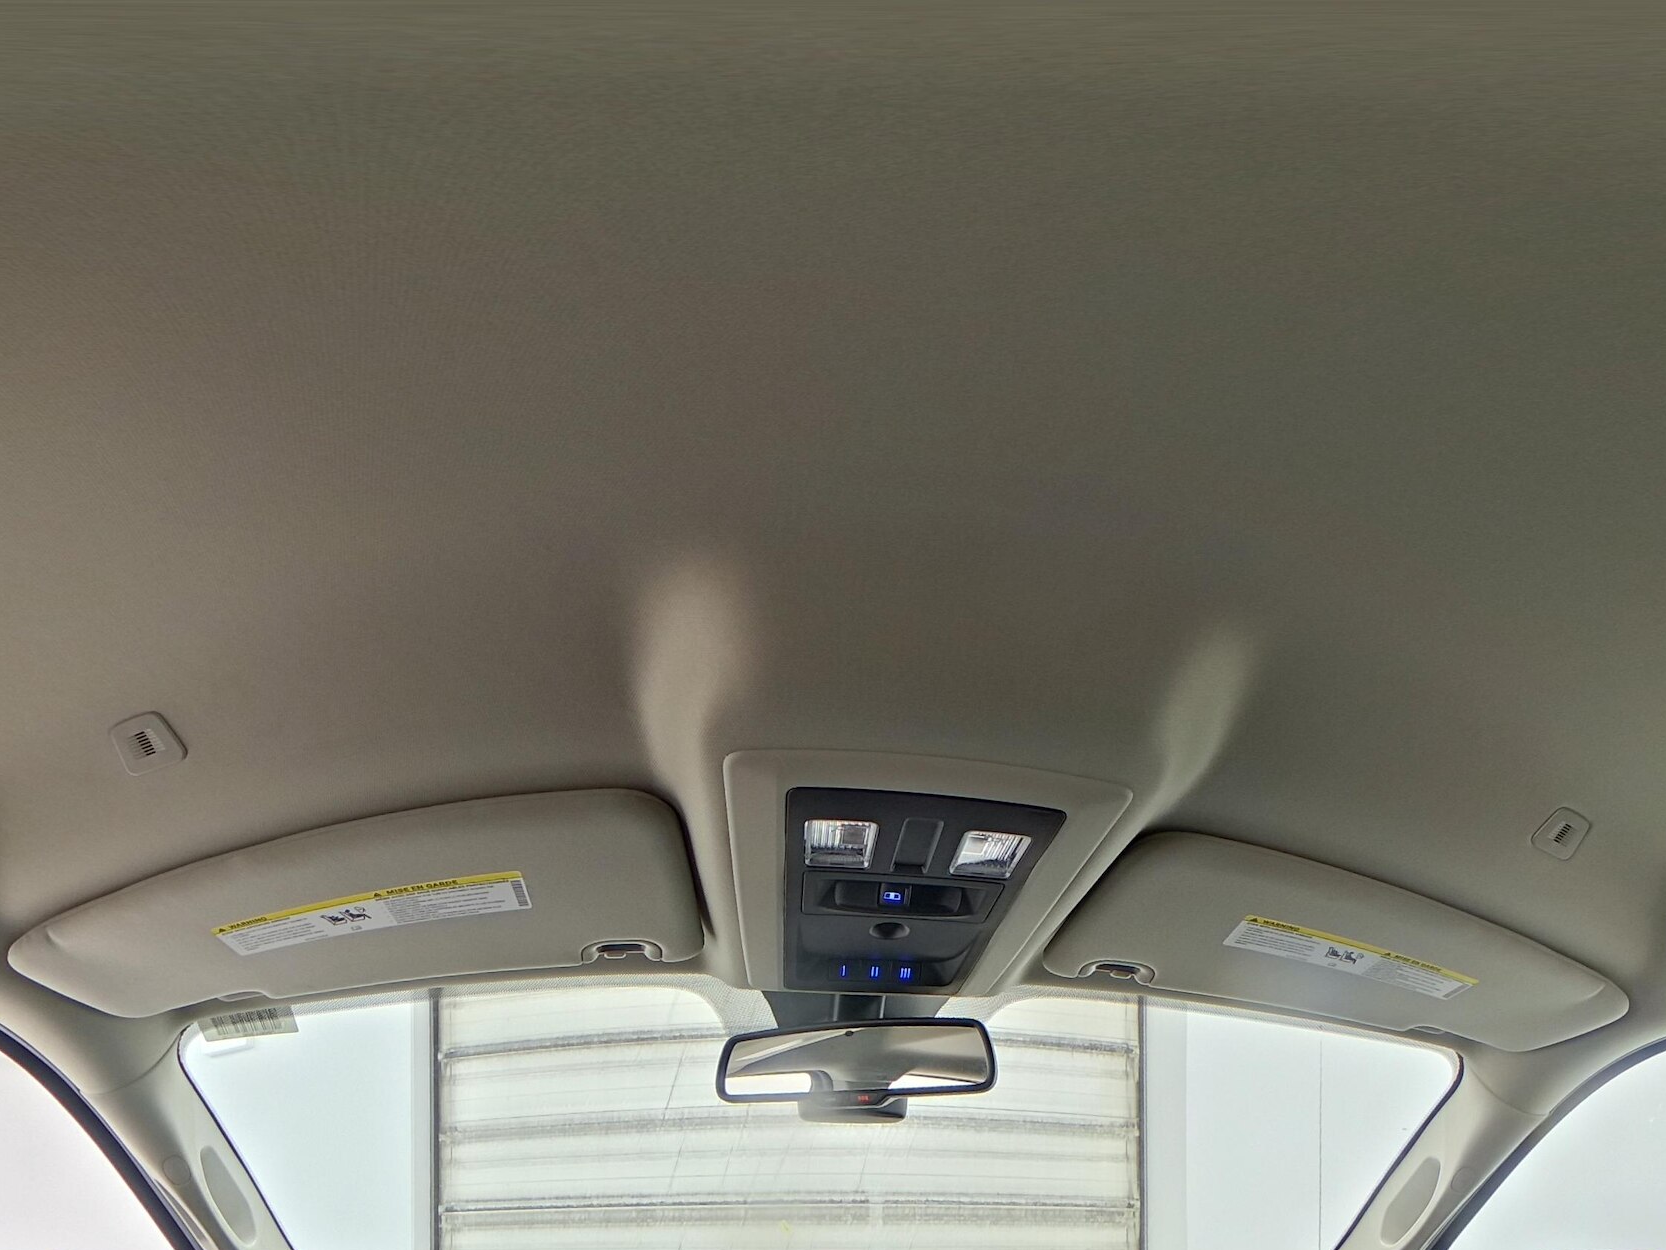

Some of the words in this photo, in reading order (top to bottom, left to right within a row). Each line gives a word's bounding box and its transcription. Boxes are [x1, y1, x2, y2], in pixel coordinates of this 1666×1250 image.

[386, 887, 409, 896] MISE
[411, 884, 424, 892] EN
[426, 879, 459, 889] GARDE
[228, 916, 268, 930] WARNING
